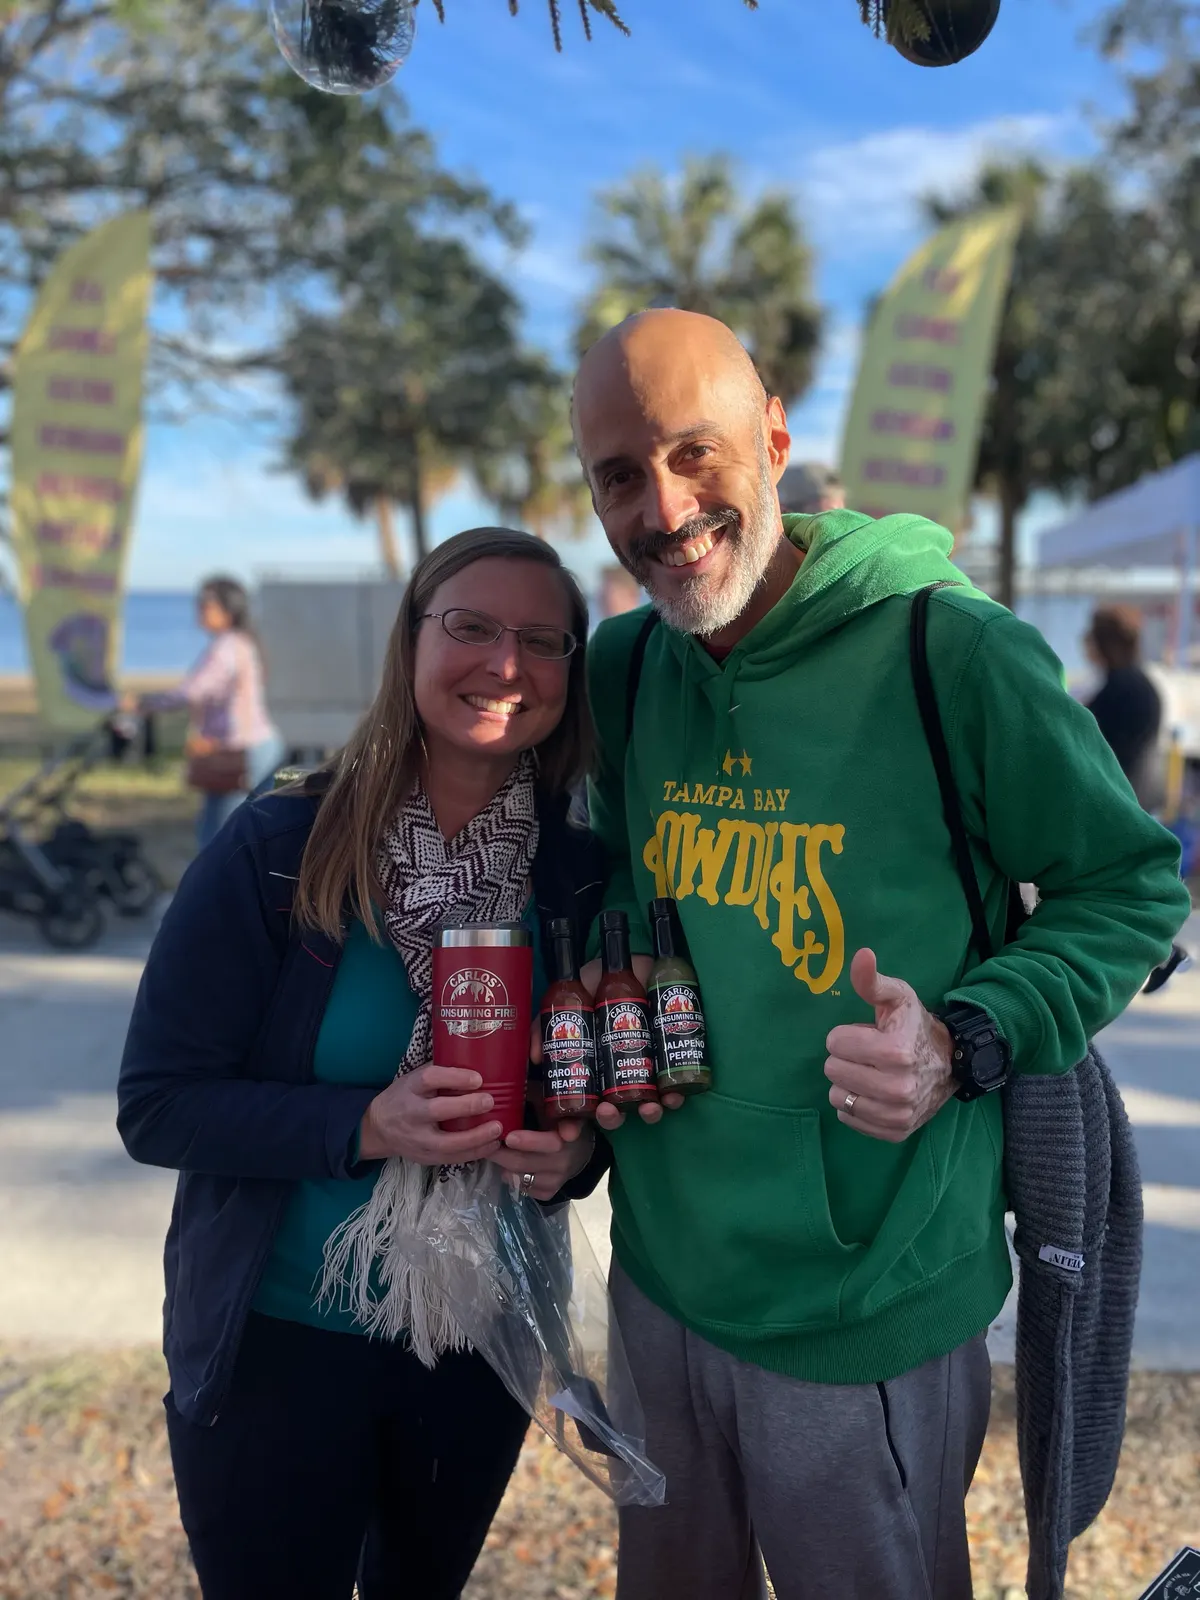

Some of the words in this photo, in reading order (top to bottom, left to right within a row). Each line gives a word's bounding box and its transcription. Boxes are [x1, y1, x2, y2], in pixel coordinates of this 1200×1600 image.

[663, 781, 746, 810] TAMPA
[753, 789, 790, 811] BAY
[449, 971, 502, 988] CARLOS'
[662, 987, 696, 1001] CARLOS'
[440, 1008, 492, 1018] ONSUMING
[495, 1008, 515, 1018] FIRE
[610, 1004, 644, 1019] CARLOS'
[550, 1013, 585, 1027] CARLOS'
[654, 1013, 694, 1025] CONSUMING
[602, 1031, 641, 1043] CONSUMING
[543, 1041, 580, 1051] CONSUMING
[582, 1041, 594, 1049] FIRE
[669, 1050, 704, 1062] PEPPER
[617, 1058, 646, 1068] GHOST
[548, 1068, 590, 1078] CAROLINA
[615, 1069, 649, 1080] PEPPER
[551, 1079, 587, 1089] REAPER
